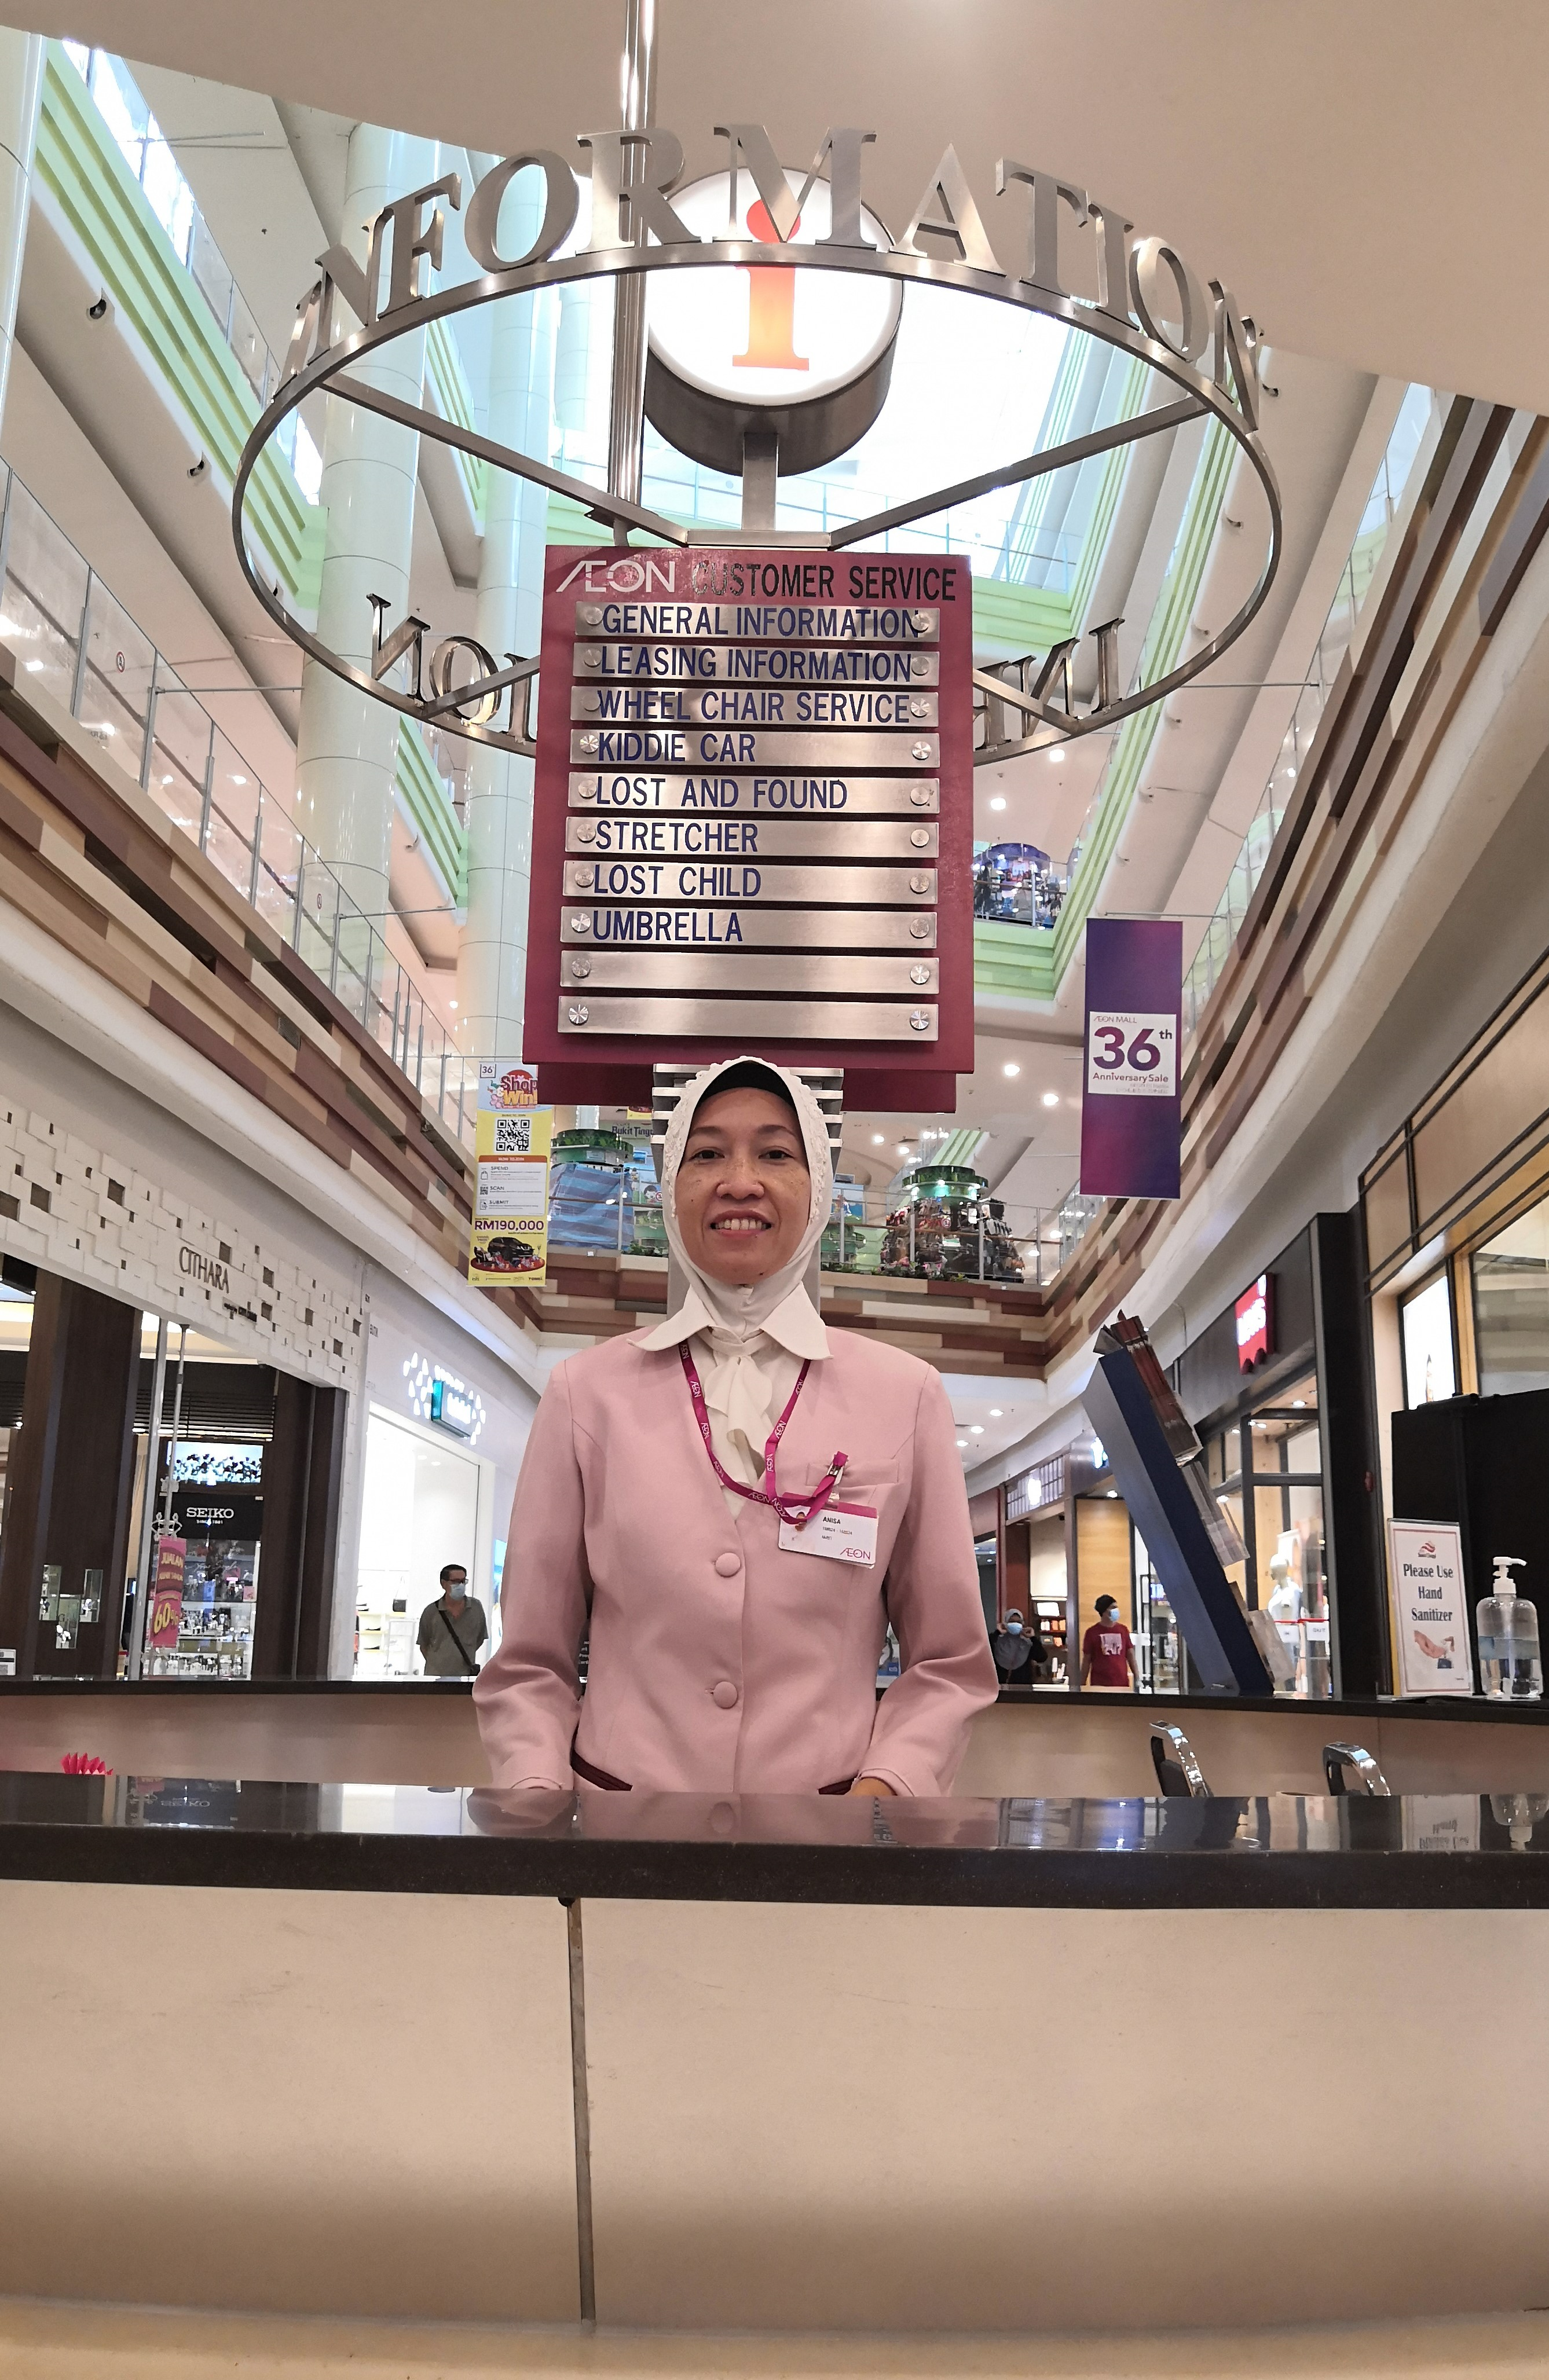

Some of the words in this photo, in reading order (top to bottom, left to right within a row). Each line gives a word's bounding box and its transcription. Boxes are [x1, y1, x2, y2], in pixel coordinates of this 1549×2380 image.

[272, 123, 1264, 431] INFORMATION
[691, 562, 835, 598] CUSTOMER
[849, 566, 957, 602] SERVICE
[602, 607, 728, 635] GENERAL
[737, 607, 920, 640] INFORMATION
[601, 647, 717, 677] LEASING
[727, 648, 911, 682] INFORMATION
[598, 690, 691, 720] WHEEL
[701, 691, 784, 722] CHAIR
[796, 693, 910, 724] SERVICE
[598, 733, 686, 762] KIDDIE
[700, 733, 756, 762] CAR
[596, 776, 667, 805] LOST
[682, 779, 739, 808] AND
[753, 779, 848, 809] FOUND
[595, 821, 758, 853] STRETCHER
[593, 864, 663, 895] LOST
[678, 866, 761, 897] CHILD
[592, 911, 744, 943] UMBRELLA
[501, 1076, 538, 1095] Shop
[1093, 1072, 1148, 1083] Anniversary
[1149, 1074, 1169, 1082] Sale
[612, 1125, 632, 1135] Bukit
[474, 1220, 544, 1231] RM190,000
[179, 1246, 230, 1294] CITHARA
[186, 1507, 235, 1519] SEIKO
[823, 1516, 841, 1525] ANISA
[1403, 1563, 1434, 1578] Please
[1436, 1565, 1454, 1578] Use
[1418, 1586, 1442, 1600] Hand
[1411, 1607, 1453, 1622] Sanitizer
